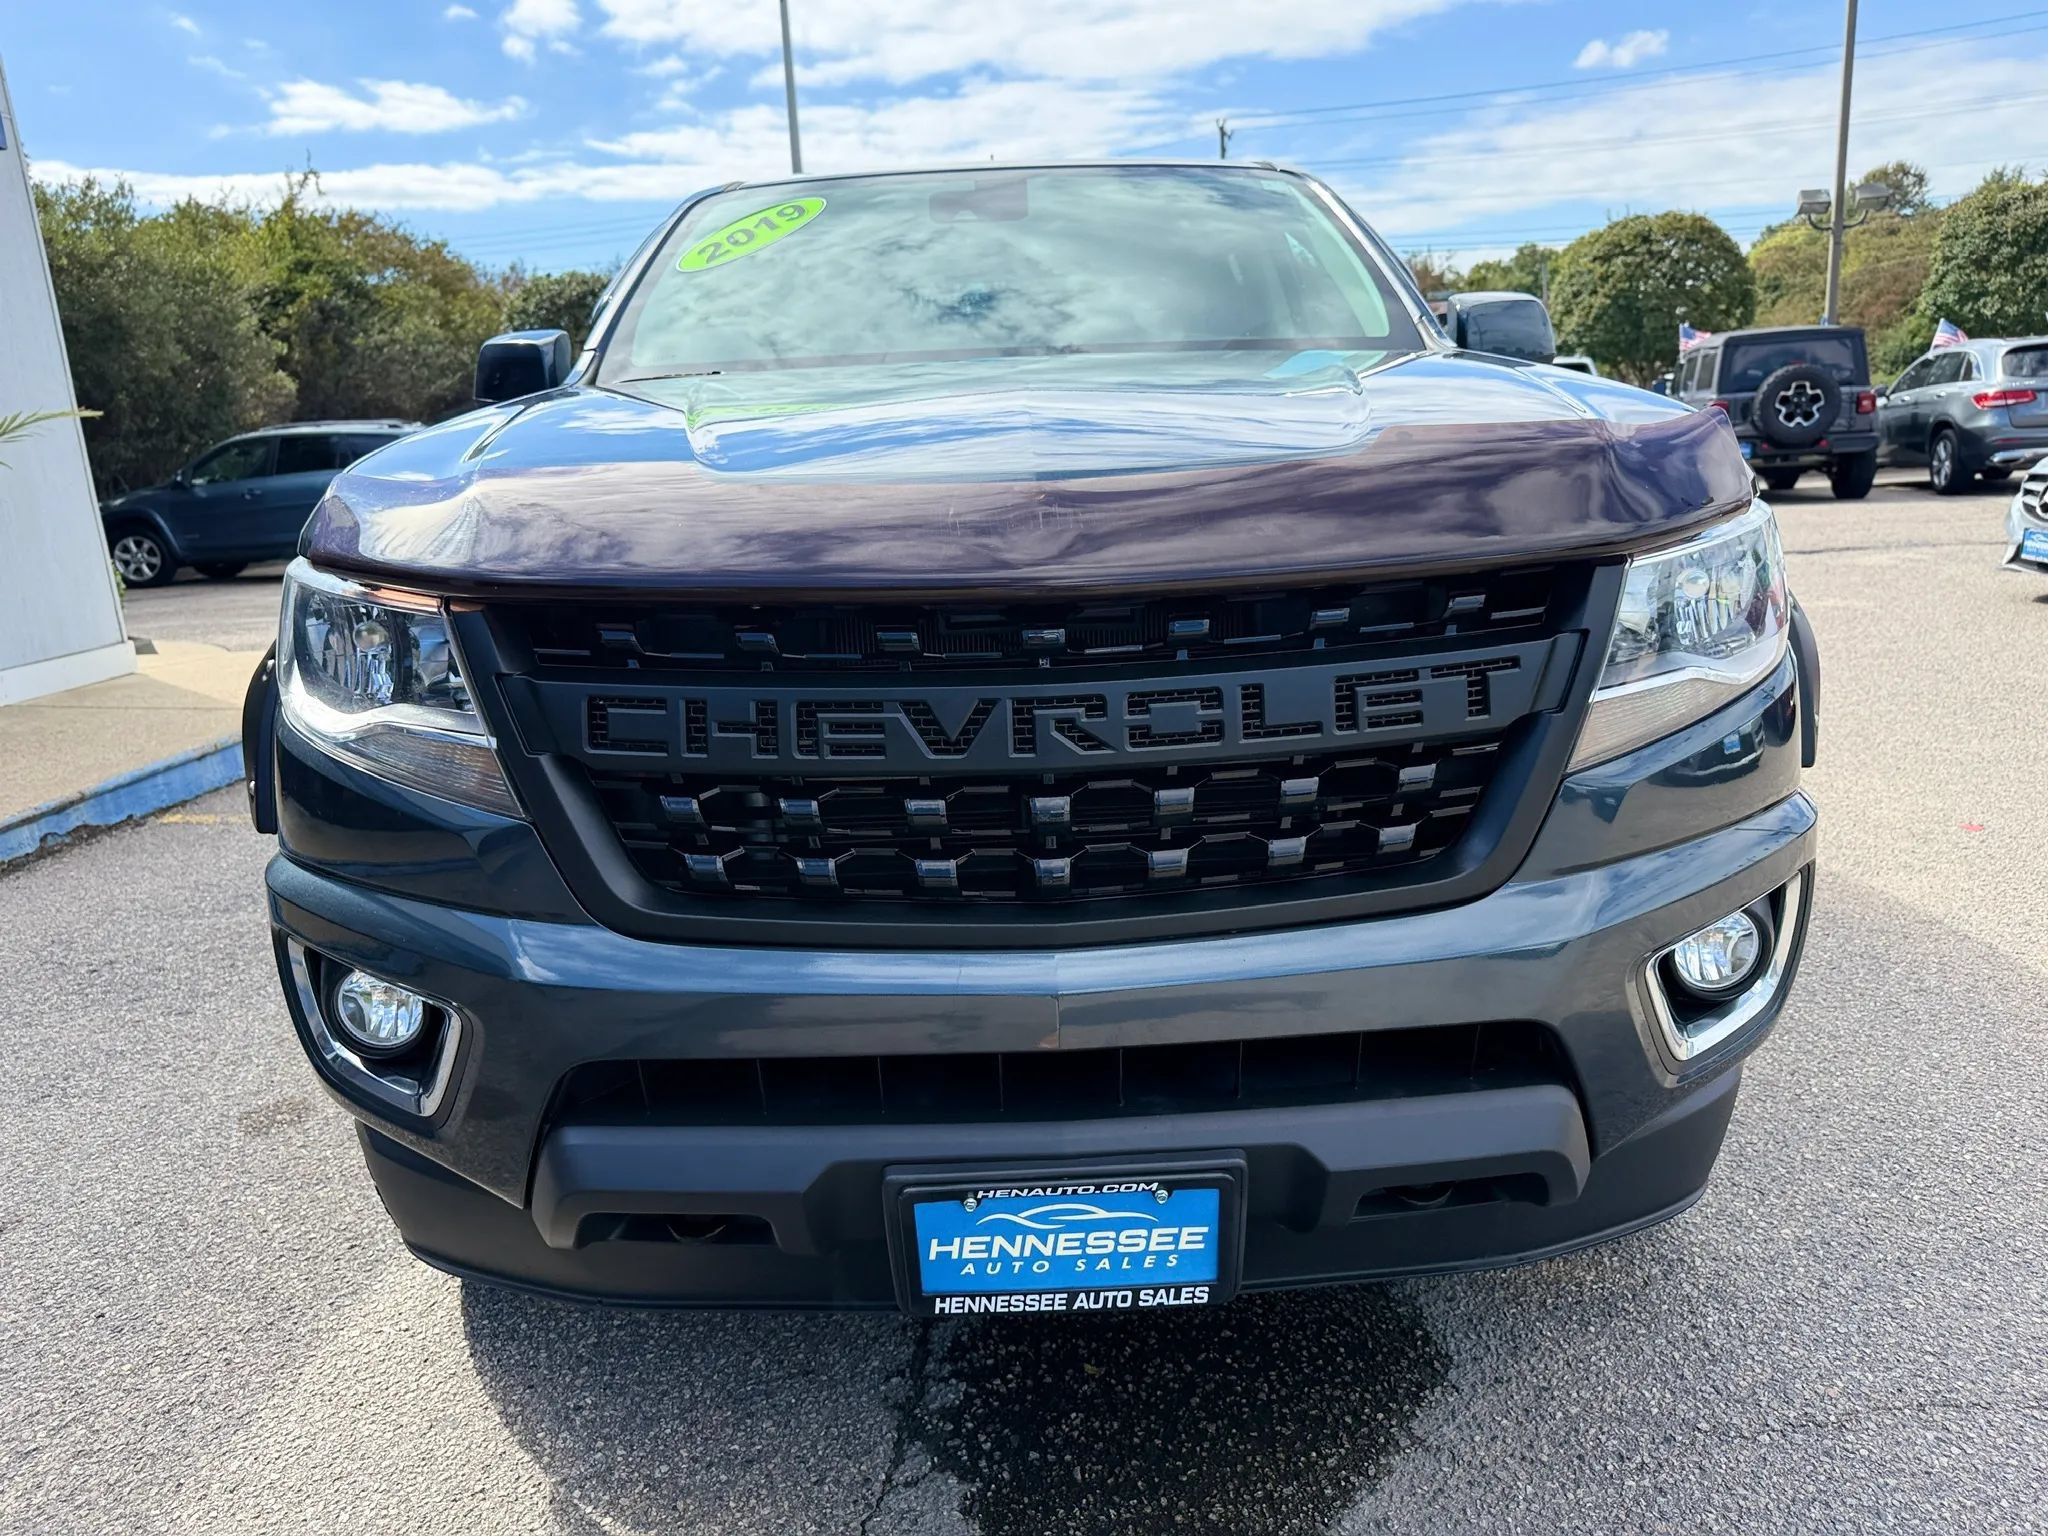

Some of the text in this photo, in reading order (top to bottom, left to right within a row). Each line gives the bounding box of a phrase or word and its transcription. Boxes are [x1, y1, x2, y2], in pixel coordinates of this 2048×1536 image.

[698, 204, 806, 264] 2019
[583, 655, 1520, 759] CHEVROLET
[976, 1182, 1159, 1199] HENAUTO.COM
[928, 1226, 1209, 1261] HENNESSEE
[960, 1254, 1179, 1275] AUTO SALES
[934, 1286, 1210, 1315] HENNESSEE AUTO SALES
